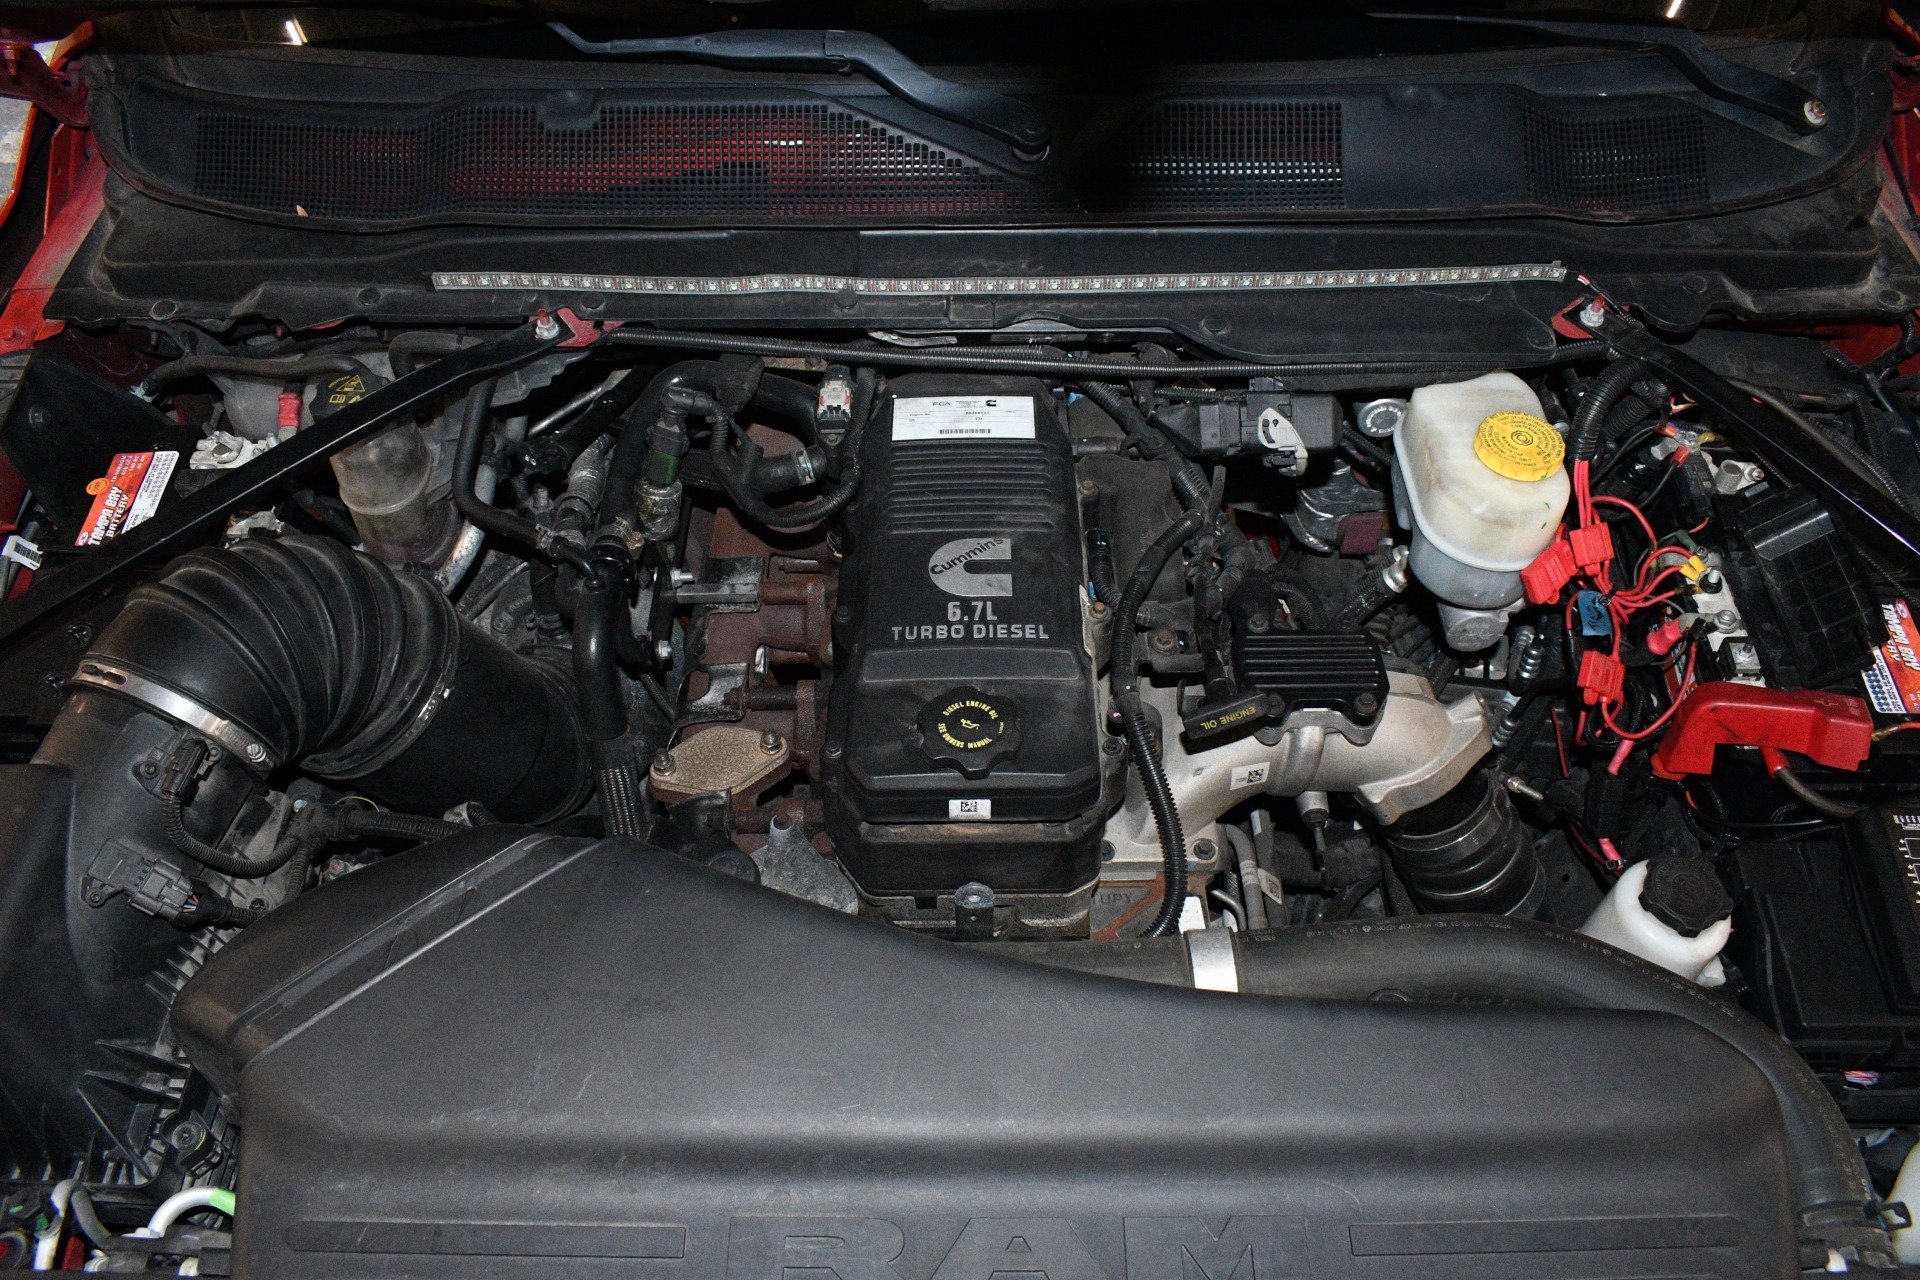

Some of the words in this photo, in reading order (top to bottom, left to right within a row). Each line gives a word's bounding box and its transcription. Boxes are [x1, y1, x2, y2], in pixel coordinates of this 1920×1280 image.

[87, 508, 114, 545] TAMPA
[104, 486, 123, 508] BAY
[105, 494, 130, 537] BATTERY
[930, 538, 1004, 575] Cummins
[947, 601, 998, 622] 6.7L
[891, 625, 965, 641] TURBO
[973, 623, 1050, 640] DIESEL
[1881, 604, 1910, 645] TAMPA
[1898, 645, 1920, 671] BAY
[942, 701, 964, 716] DIESEL
[966, 700, 991, 712] ENGINE
[988, 709, 999, 720] OIL
[1219, 706, 1256, 725] ENGINE
[938, 723, 948, 734] SEE
[968, 737, 993, 749] MANUAL
[1200, 720, 1218, 730] OIL
[727, 1216, 1310, 1280] RAM
